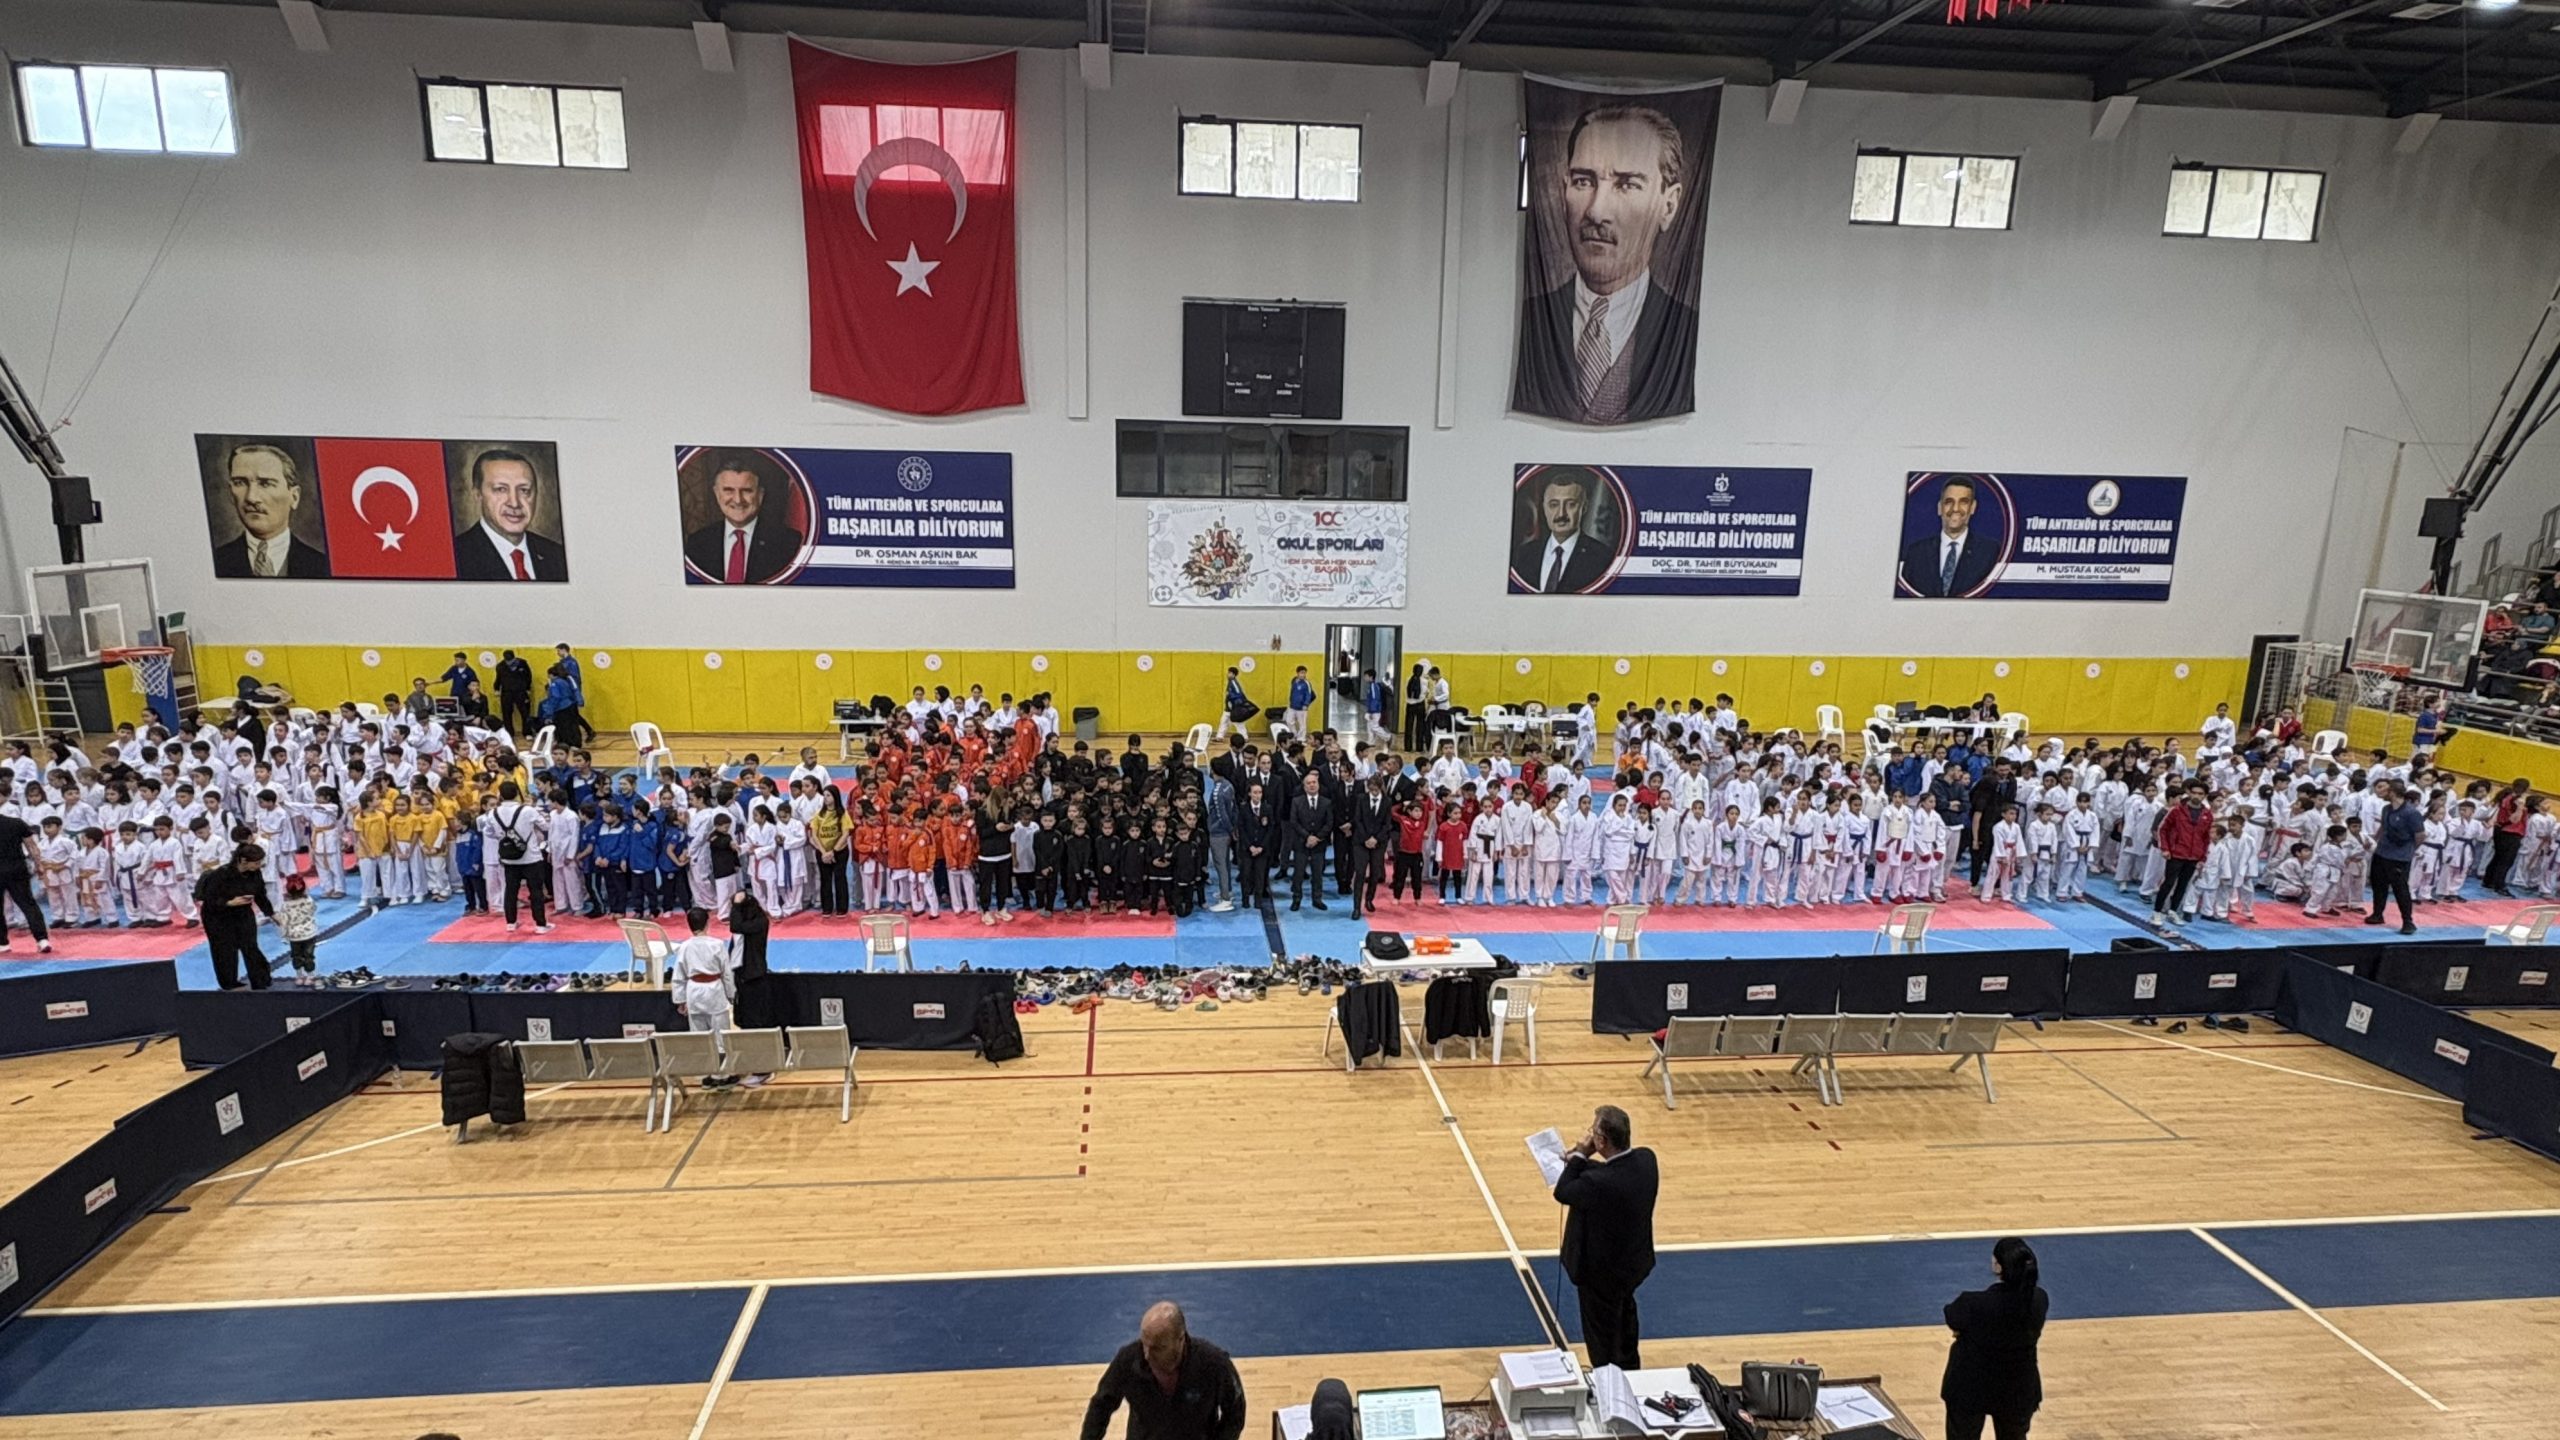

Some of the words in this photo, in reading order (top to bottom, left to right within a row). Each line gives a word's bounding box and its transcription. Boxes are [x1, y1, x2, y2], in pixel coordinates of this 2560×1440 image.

[826, 495, 851, 511] TÜM
[854, 497, 913, 512] ANTRENÖR
[915, 499, 928, 512] VE
[930, 500, 1004, 513] SPORCULARA
[1640, 509, 1662, 524] TÜM
[1664, 510, 1716, 525] ANTRENÖR
[1718, 513, 1730, 525] VE
[1732, 513, 1797, 526] SPORCULARA
[2026, 516, 2047, 530] TÜM
[2048, 517, 2097, 531] ANTRENÖR
[2099, 519, 2111, 531] VE
[2111, 520, 2173, 532] SPORCULARA
[827, 518, 915, 539] BAŞARILAR
[919, 517, 1004, 538] DİLİYORUM
[1277, 537, 1315, 551] OKUL
[1316, 538, 1385, 551] SPORLARI
[1638, 530, 1716, 550] BAŞARILAR
[1718, 529, 1795, 549] DİLİYORUM
[2022, 536, 2096, 556] BAŞARILAR
[2098, 535, 2171, 554] DİLİYORUM
[856, 549, 874, 558] DR.
[877, 550, 917, 559] OSMAN
[920, 550, 953, 560] AŞKIN
[956, 551, 978, 559] BAK
[1652, 559, 1674, 569] DOÇ.
[1677, 559, 1692, 567] DR.
[1695, 559, 1722, 568] TAHİR
[1724, 559, 1777, 568] BÜYÜKAKIN
[2049, 566, 2091, 574] MUSTAFA
[2094, 566, 2141, 574] KOCAMAN
